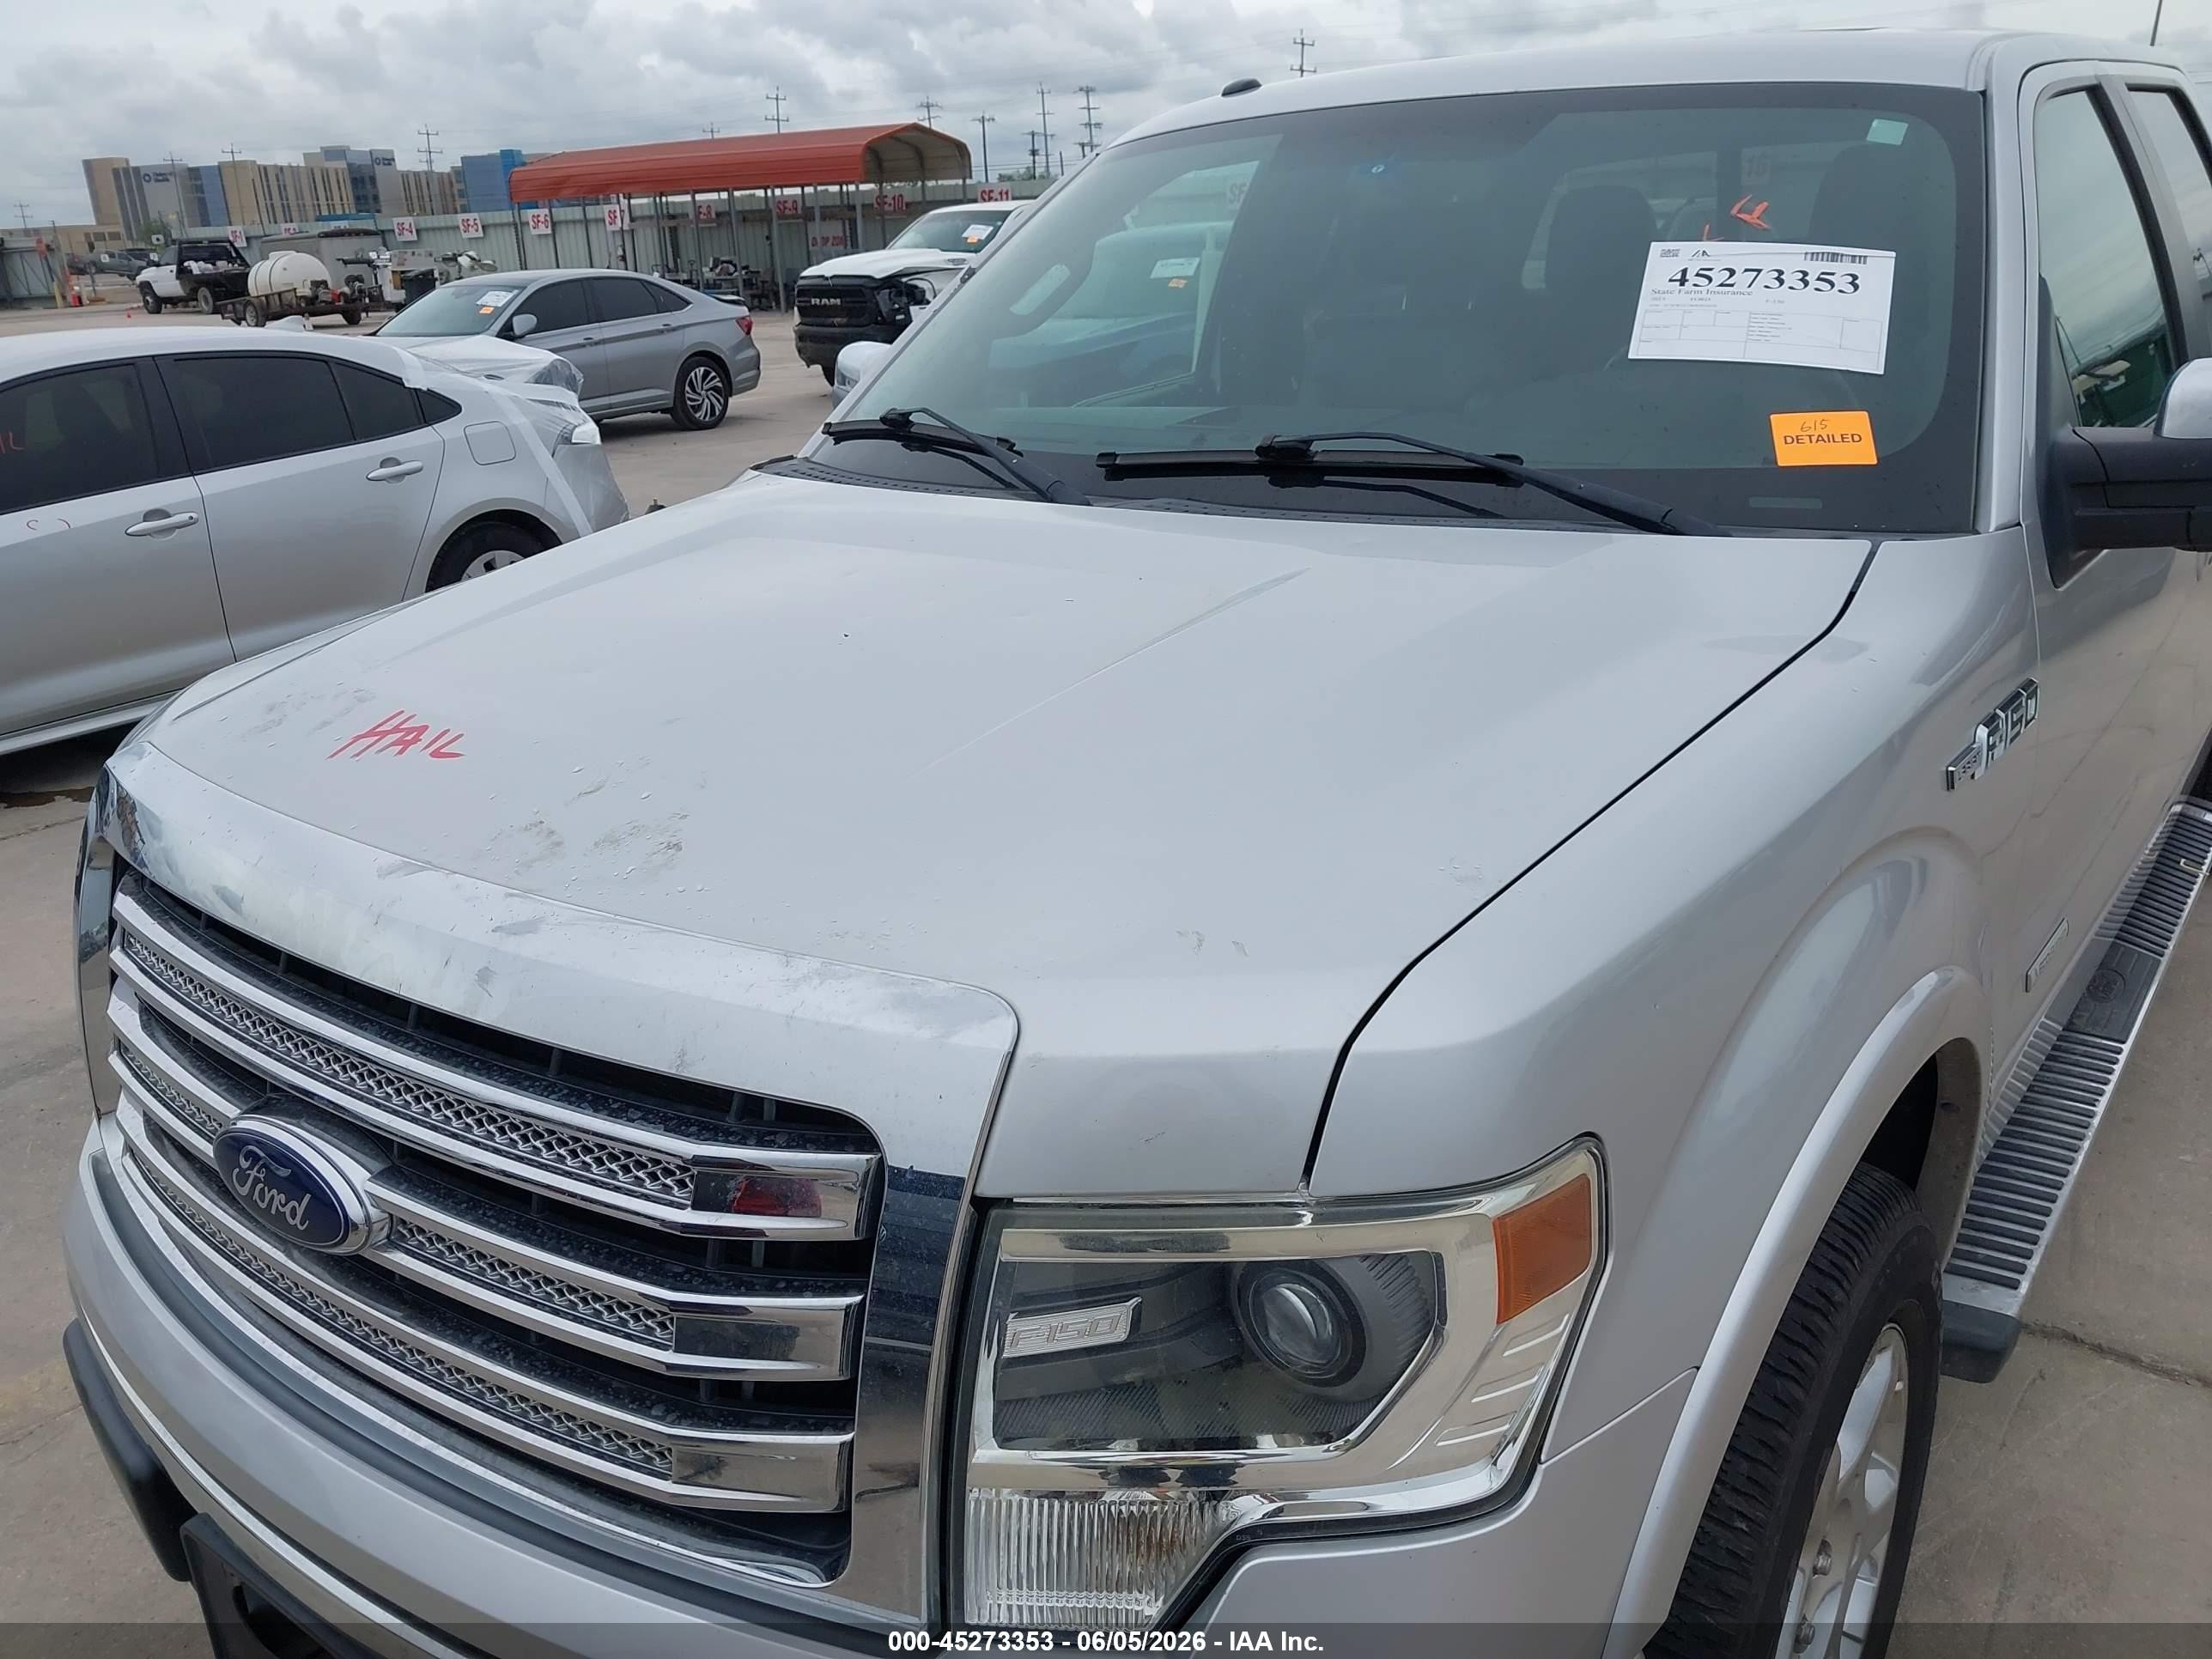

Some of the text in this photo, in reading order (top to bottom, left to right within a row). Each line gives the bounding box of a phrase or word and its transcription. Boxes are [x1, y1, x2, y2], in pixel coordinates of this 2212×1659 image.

[461, 218, 479, 234] SF-5
[531, 214, 550, 229] SF-6
[397, 222, 414, 237] SF-4
[1668, 266, 1861, 295] 45273353
[1705, 289, 1753, 297] Insurance
[811, 297, 842, 306] RAM
[1800, 418, 1830, 433] 615
[1784, 433, 1863, 445] DETAILED
[325, 709, 465, 760] HAIL
[233, 1145, 312, 1231] Ford
